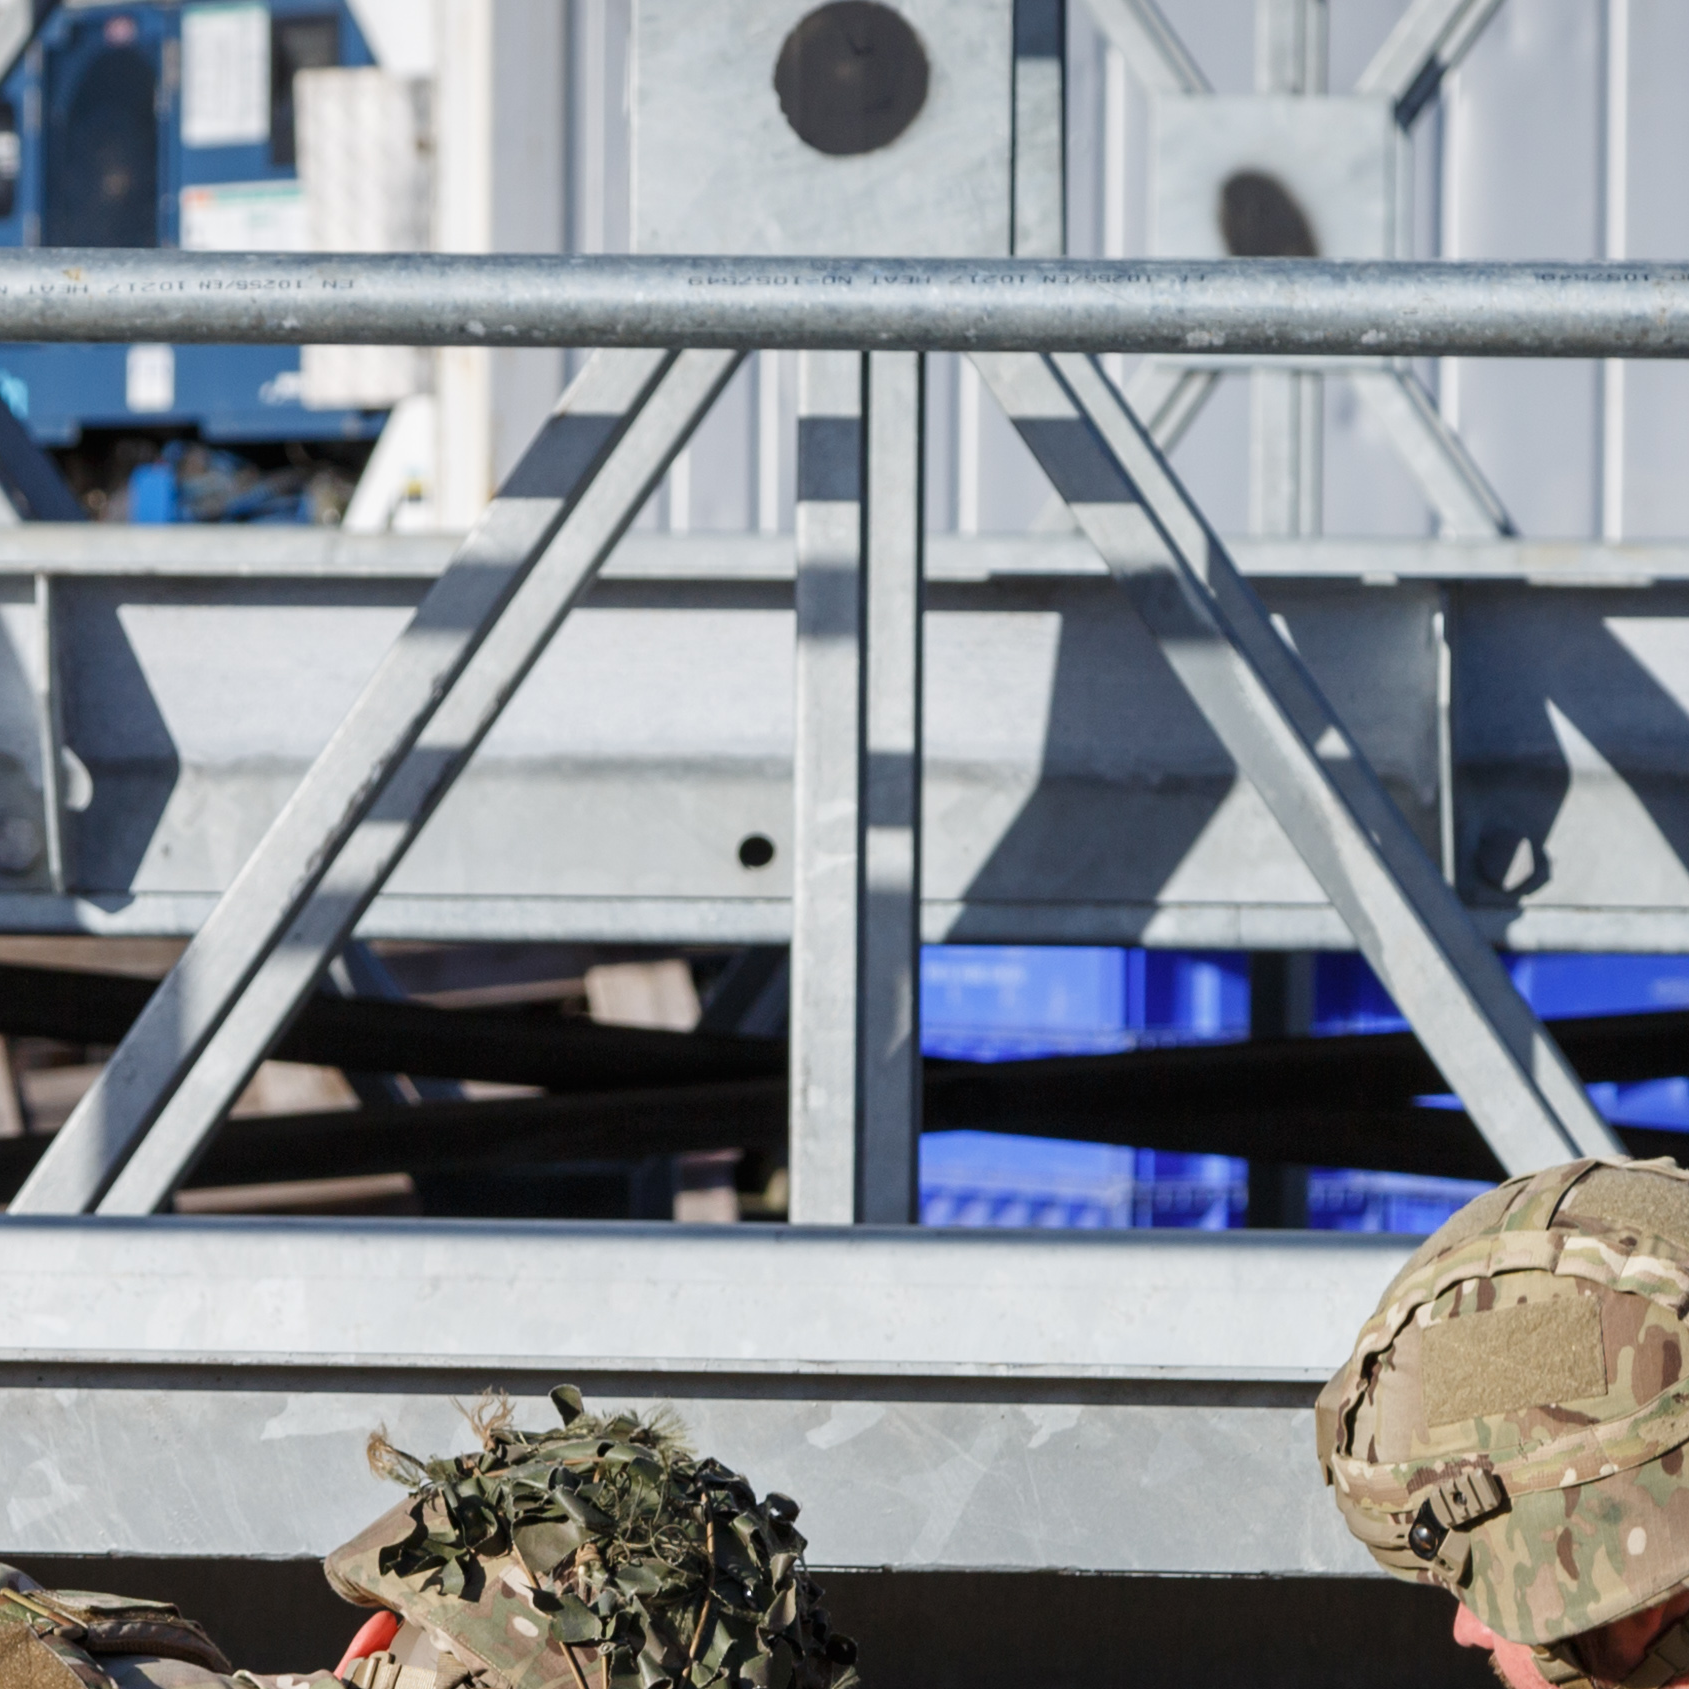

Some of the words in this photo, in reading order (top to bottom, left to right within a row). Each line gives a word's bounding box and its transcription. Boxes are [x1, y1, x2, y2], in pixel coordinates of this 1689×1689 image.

[199, 279, 302, 290] 10255/EN
[322, 279, 354, 289] EN
[871, 275, 931, 285] HEAT
[28, 284, 88, 294] HEAT
[107, 281, 184, 292] 10217
